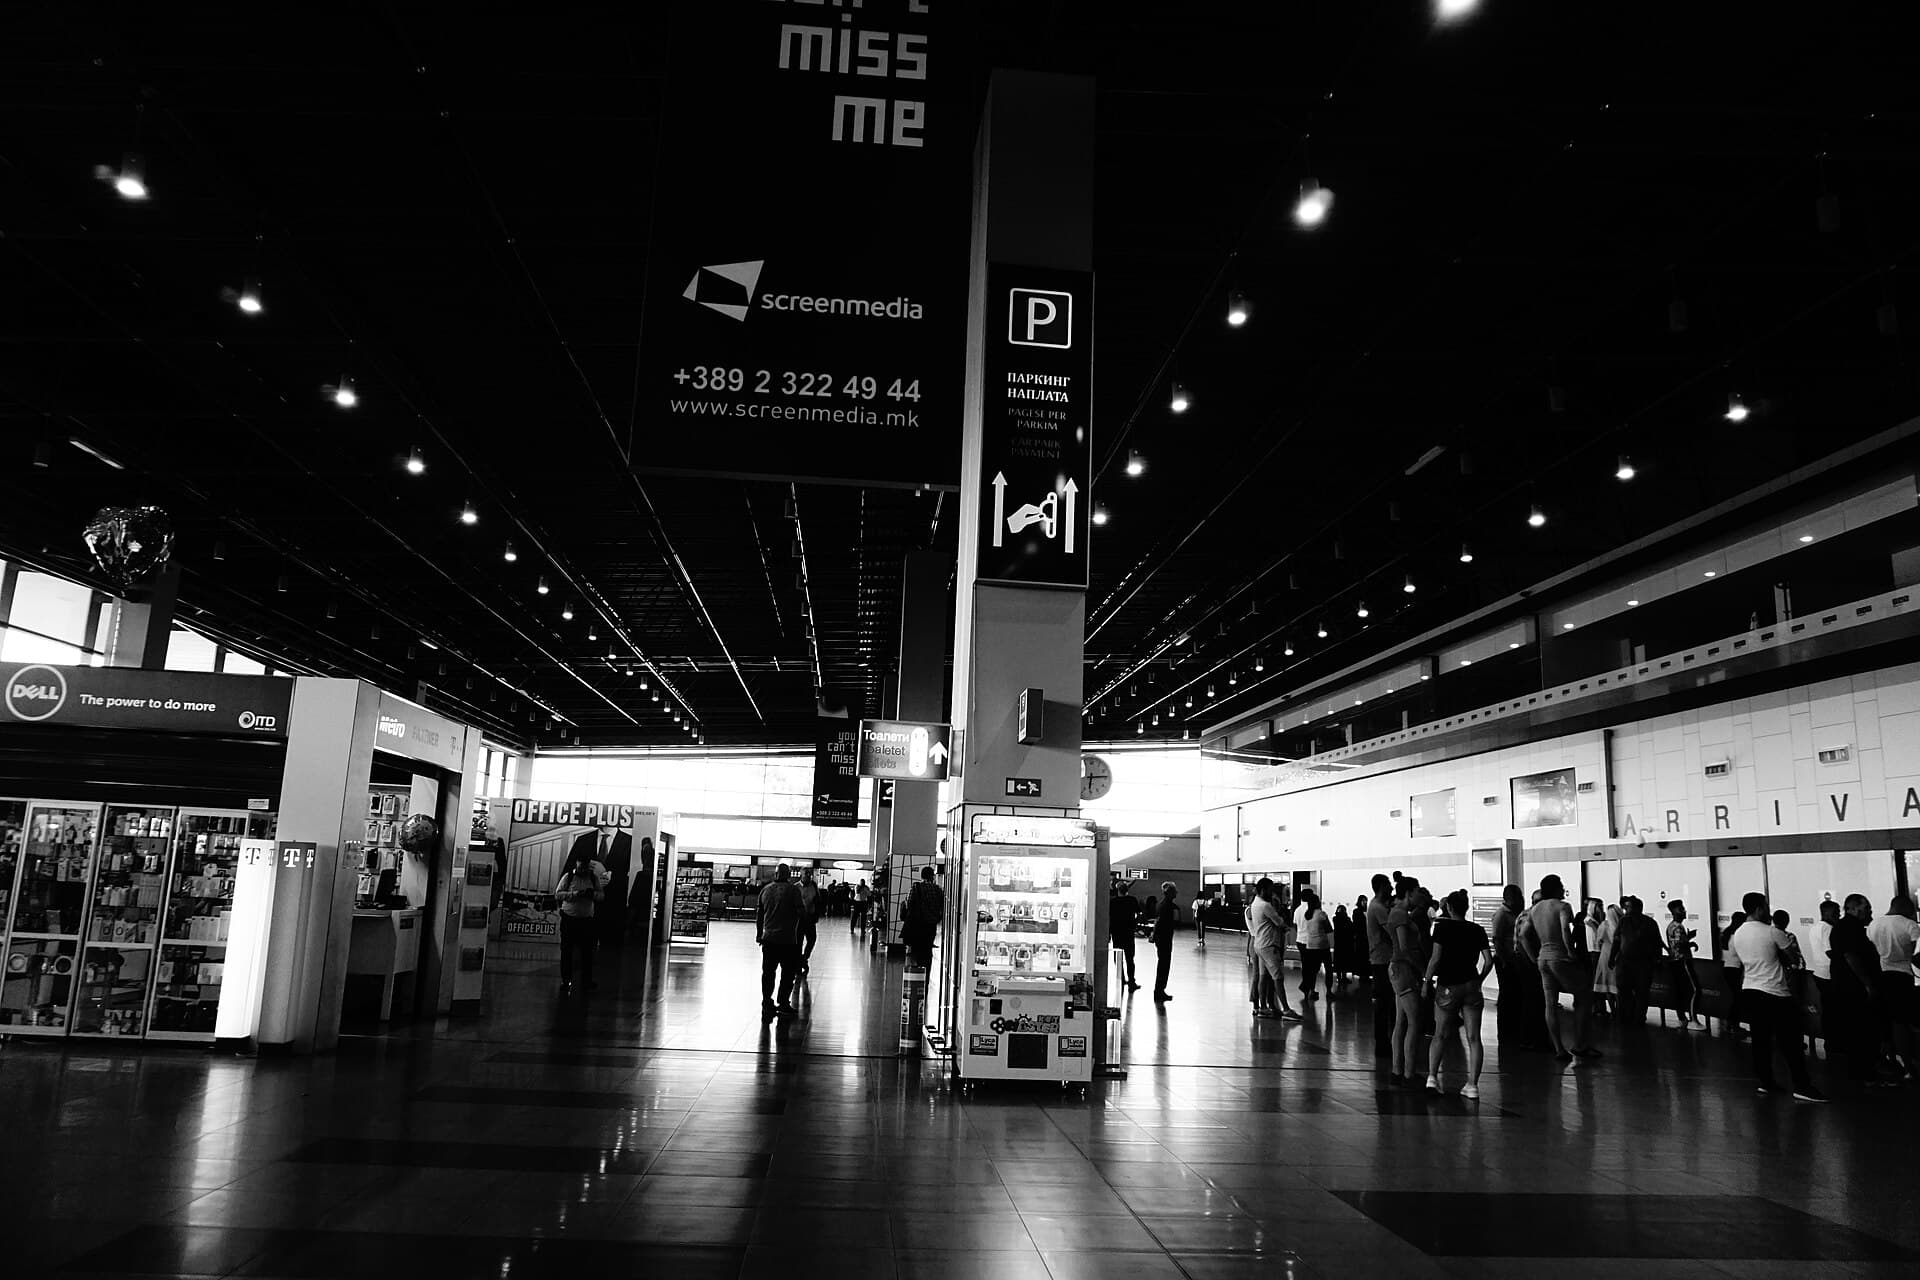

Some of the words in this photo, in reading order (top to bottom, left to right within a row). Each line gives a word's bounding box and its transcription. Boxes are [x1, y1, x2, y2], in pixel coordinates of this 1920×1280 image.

[778, 13, 928, 80] miss
[832, 95, 925, 148] me
[761, 294, 923, 319] screenmedia
[1027, 297, 1057, 341] P
[673, 366, 744, 391] +389
[754, 370, 771, 393] 2
[782, 372, 833, 397] 322
[843, 376, 877, 400] 49
[887, 378, 921, 402] 44
[1007, 372, 1071, 387] ПАРКИНГ
[1007, 387, 1069, 403] НАПЛАТА
[671, 399, 919, 428] www.screenmedia.mk
[1017, 419, 1058, 431] PARKIM
[13, 684, 59, 700] DELL
[80, 694, 103, 706] The
[106, 697, 145, 709] power
[149, 698, 162, 709] to
[164, 699, 181, 710] do
[183, 701, 216, 713] more
[827, 741, 856, 753] can't
[838, 731, 856, 743] you
[831, 752, 855, 764] miss
[839, 765, 854, 776] me
[514, 800, 581, 825] OFFICE
[584, 803, 632, 827] PLUS
